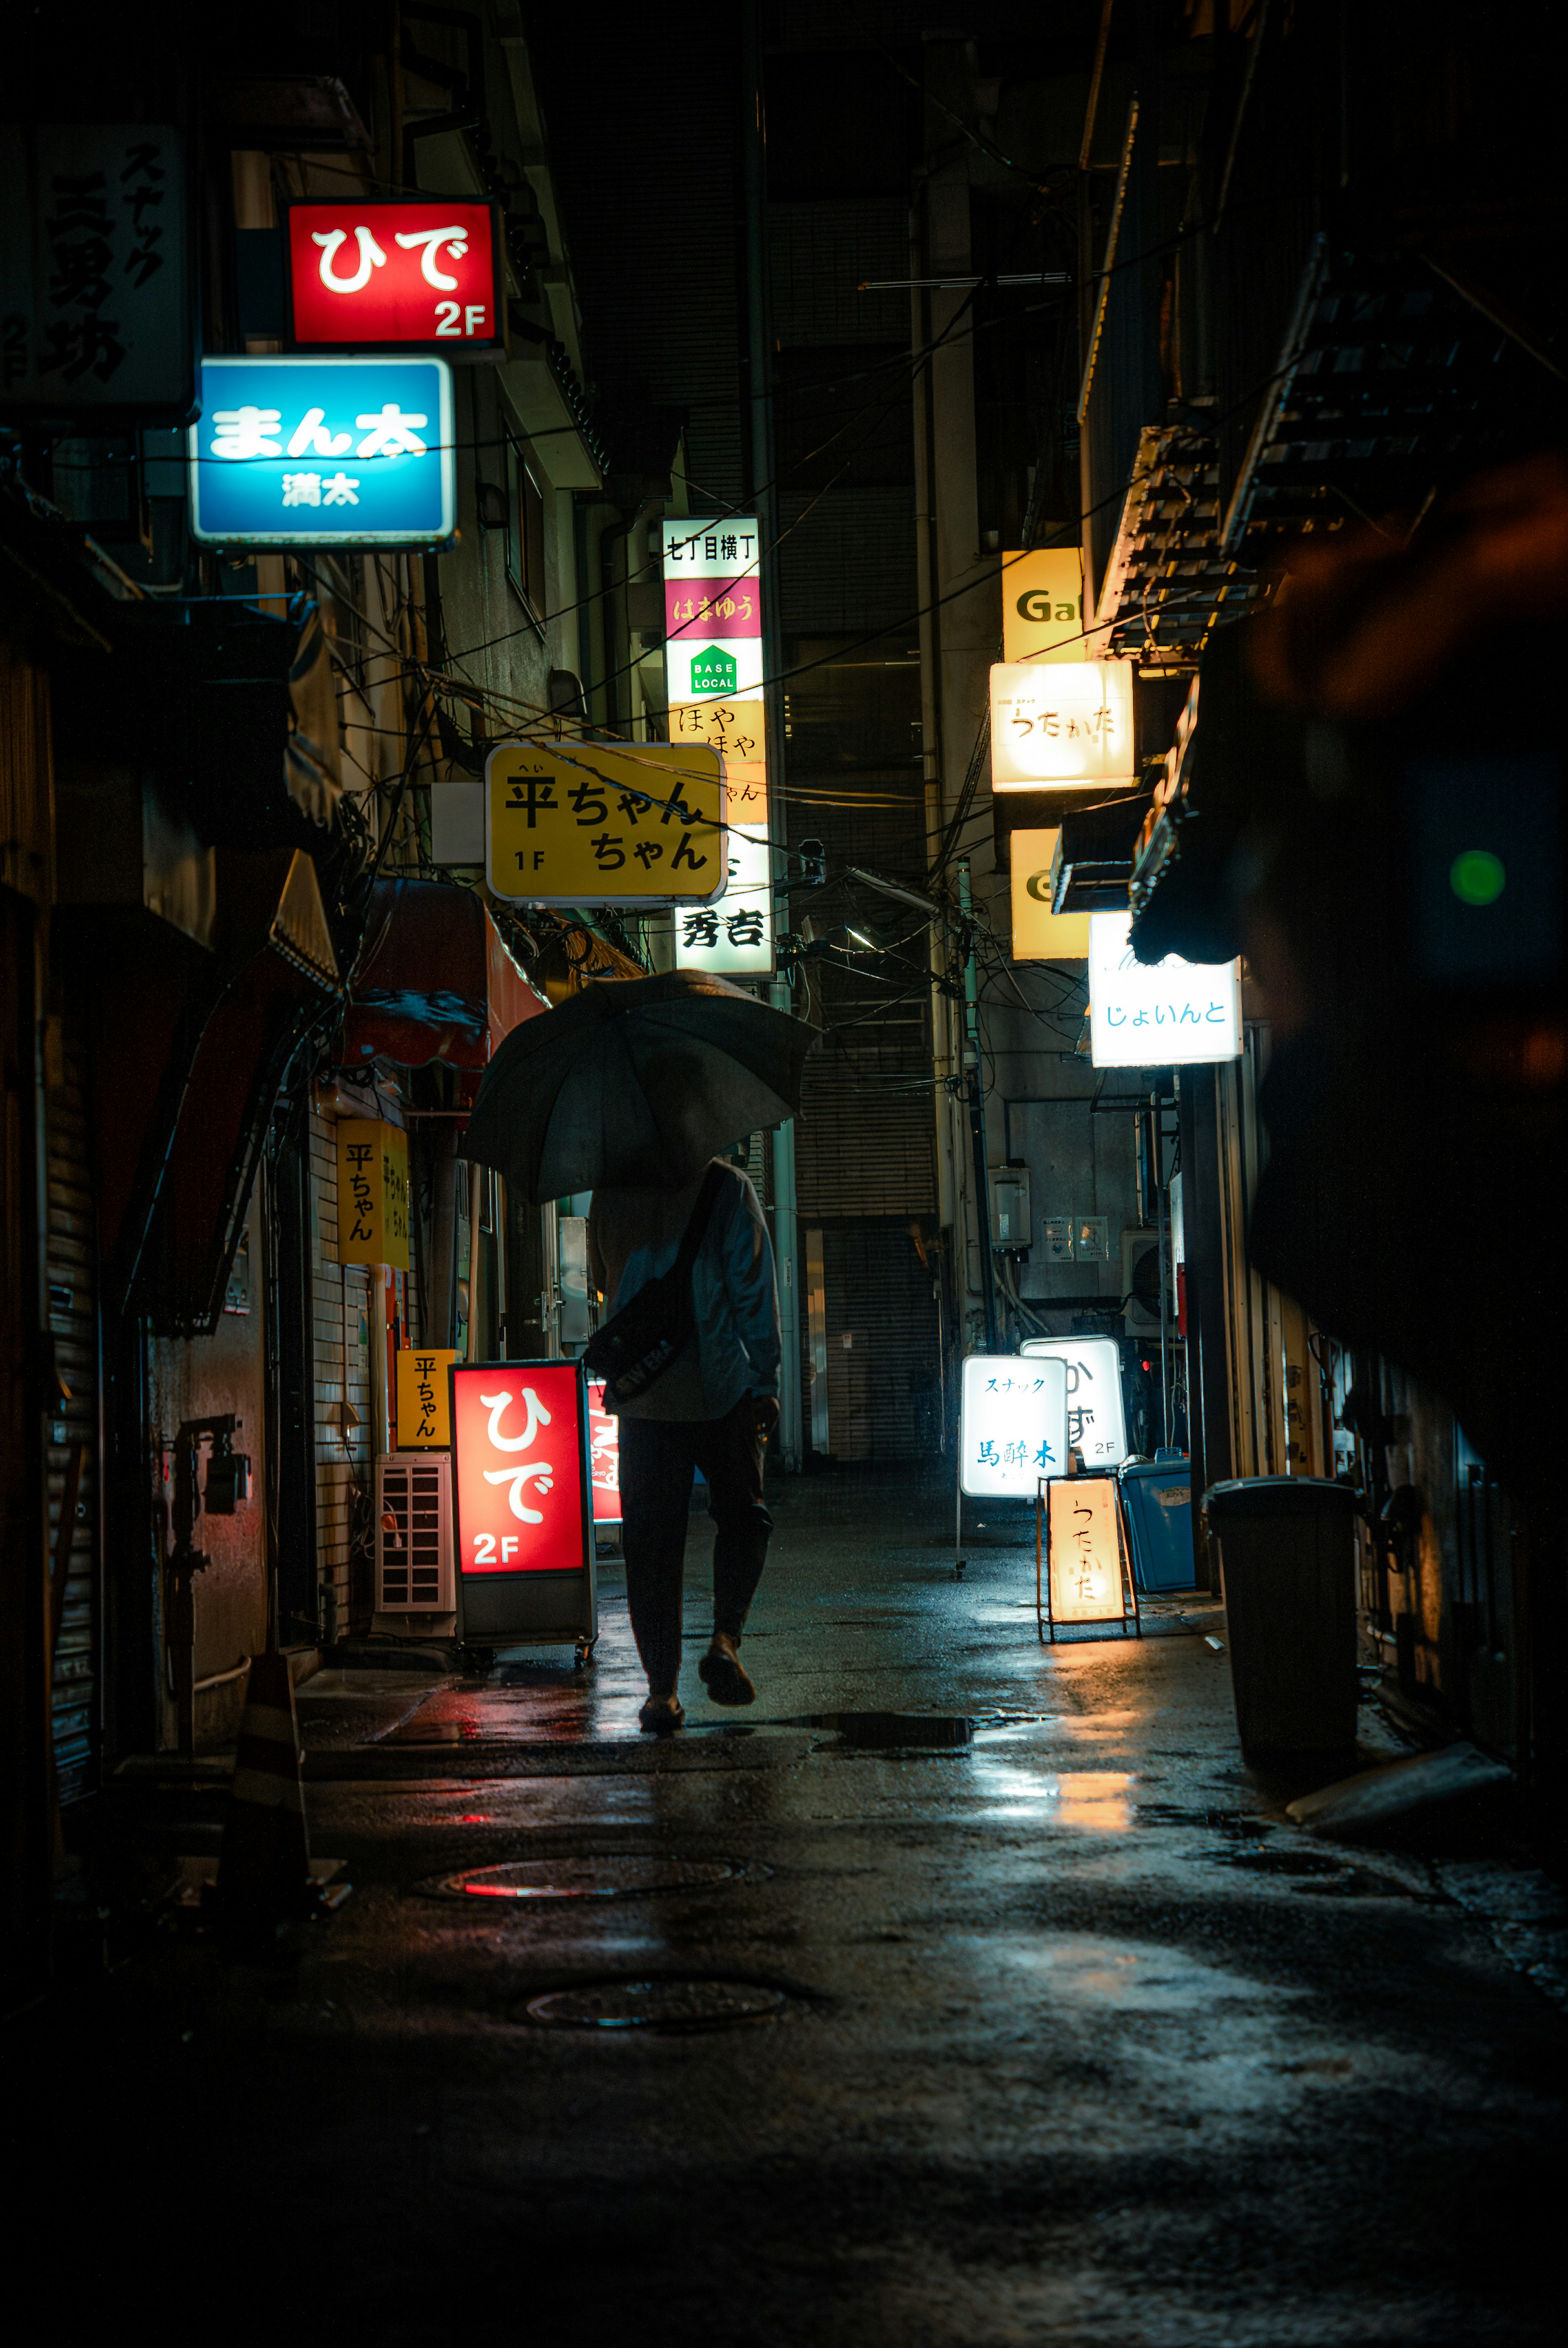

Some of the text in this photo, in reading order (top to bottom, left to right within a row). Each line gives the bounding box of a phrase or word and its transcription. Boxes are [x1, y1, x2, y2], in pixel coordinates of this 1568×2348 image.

[121, 143, 163, 288] スナック
[312, 226, 468, 294] ひで
[434, 301, 485, 336] 2F
[210, 403, 428, 460] まん太
[282, 473, 360, 507] 満太
[667, 535, 755, 560] 七丁目横丁
[673, 595, 752, 622] はまゆう
[1016, 590, 1081, 622] Ga
[694, 664, 733, 673] BASE
[695, 678, 734, 689] LOCAL
[679, 707, 735, 733] ほや
[1011, 706, 1115, 738] うたかた
[706, 736, 755, 757] ほや
[505, 777, 703, 828] 平ちゃん
[590, 832, 707, 870] ちゃん
[683, 908, 764, 948] 秀吉
[1108, 1002, 1225, 1026] じょいんと
[346, 1144, 373, 1241] 平ちゃん
[414, 1357, 437, 1437] 平ちゃん
[985, 1378, 1045, 1394] スナック
[480, 1388, 554, 1524] ひで
[978, 1440, 1056, 1468] 馬酔木
[1095, 1442, 1115, 1454] 2F
[473, 1533, 519, 1564] 2F
[1072, 1500, 1102, 1599] うたかた
